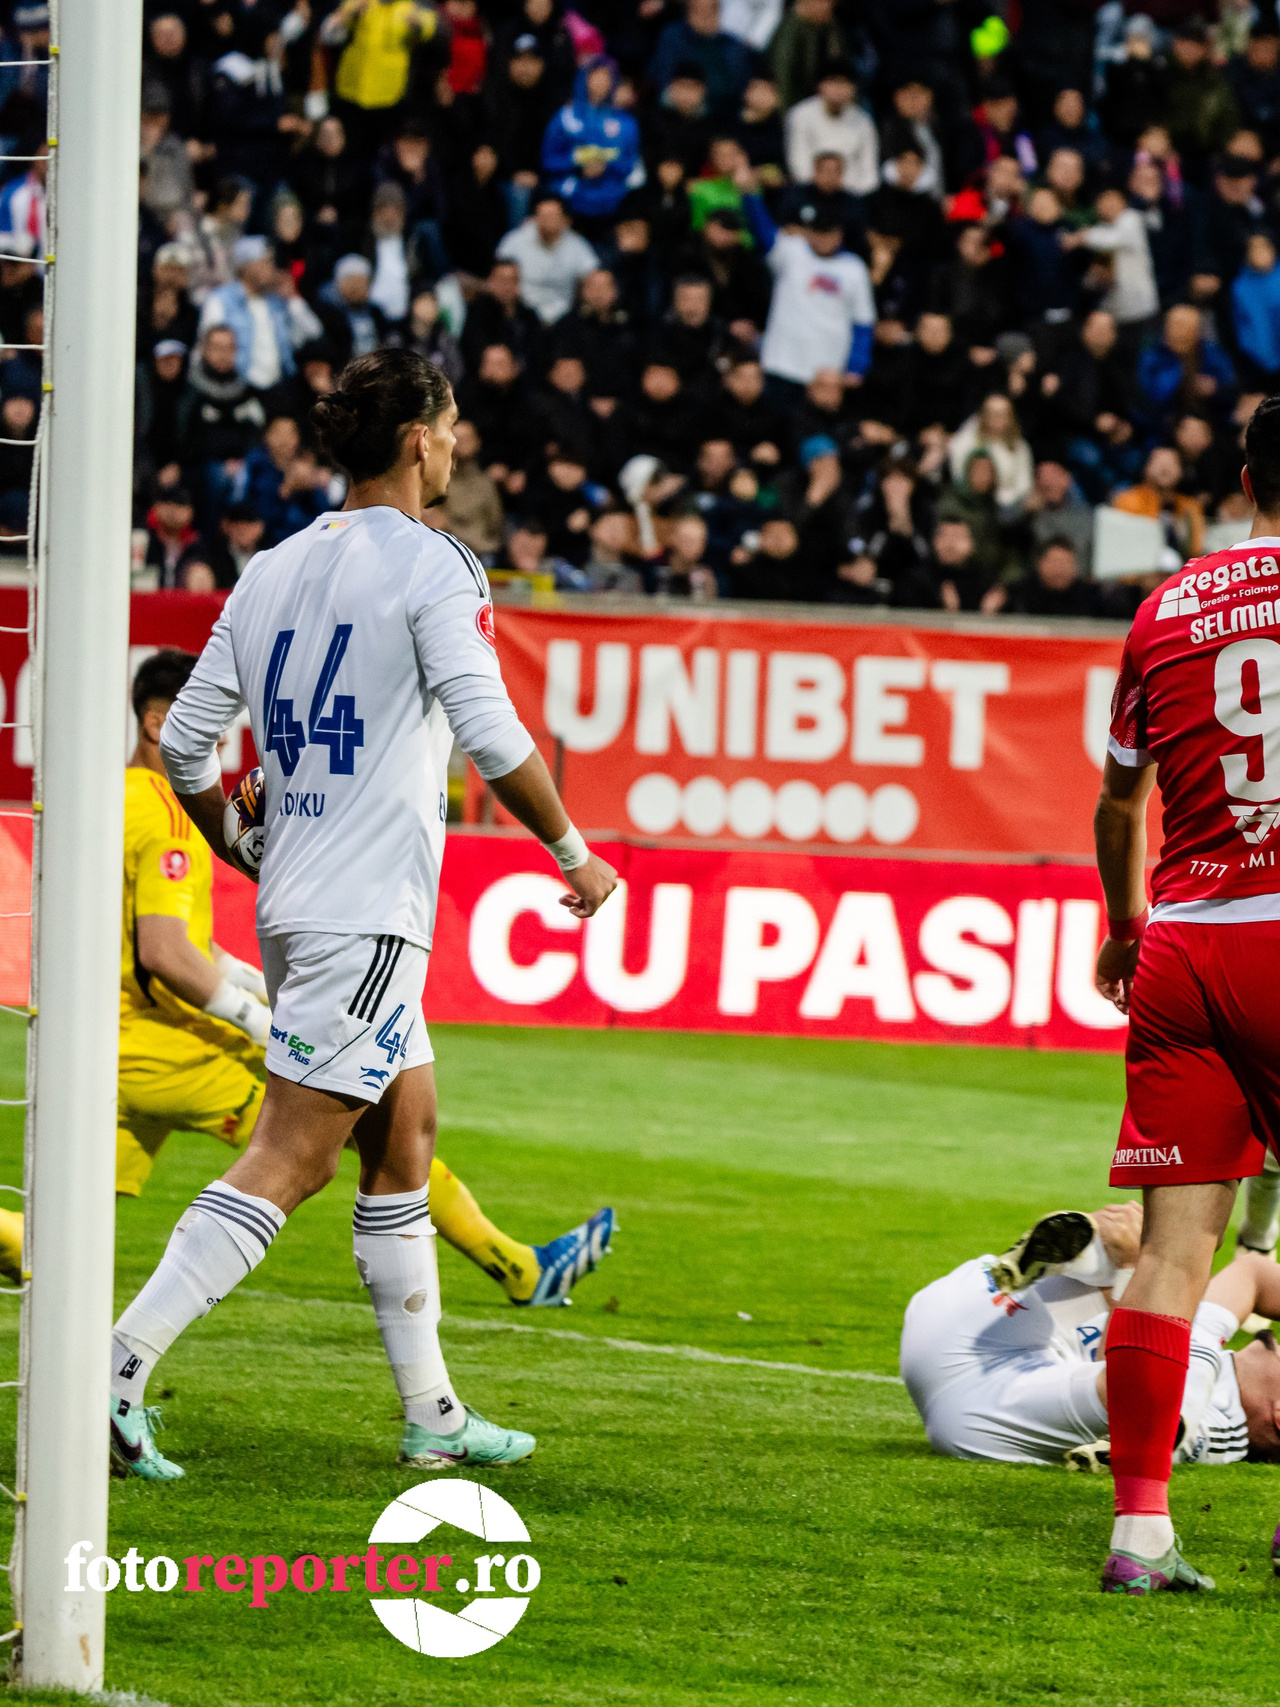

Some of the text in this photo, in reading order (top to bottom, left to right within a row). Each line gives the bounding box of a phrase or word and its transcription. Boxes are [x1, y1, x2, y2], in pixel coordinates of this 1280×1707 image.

[1200, 593, 1231, 610] Gresie
[263, 623, 365, 777] 44
[543, 638, 1011, 770] UNIBET
[279, 791, 326, 818] DIKU
[468, 871, 692, 1014] CU
[287, 1034, 316, 1056] Eco
[287, 1049, 311, 1066] Plus
[1113, 1145, 1184, 1165] ARPATINA
